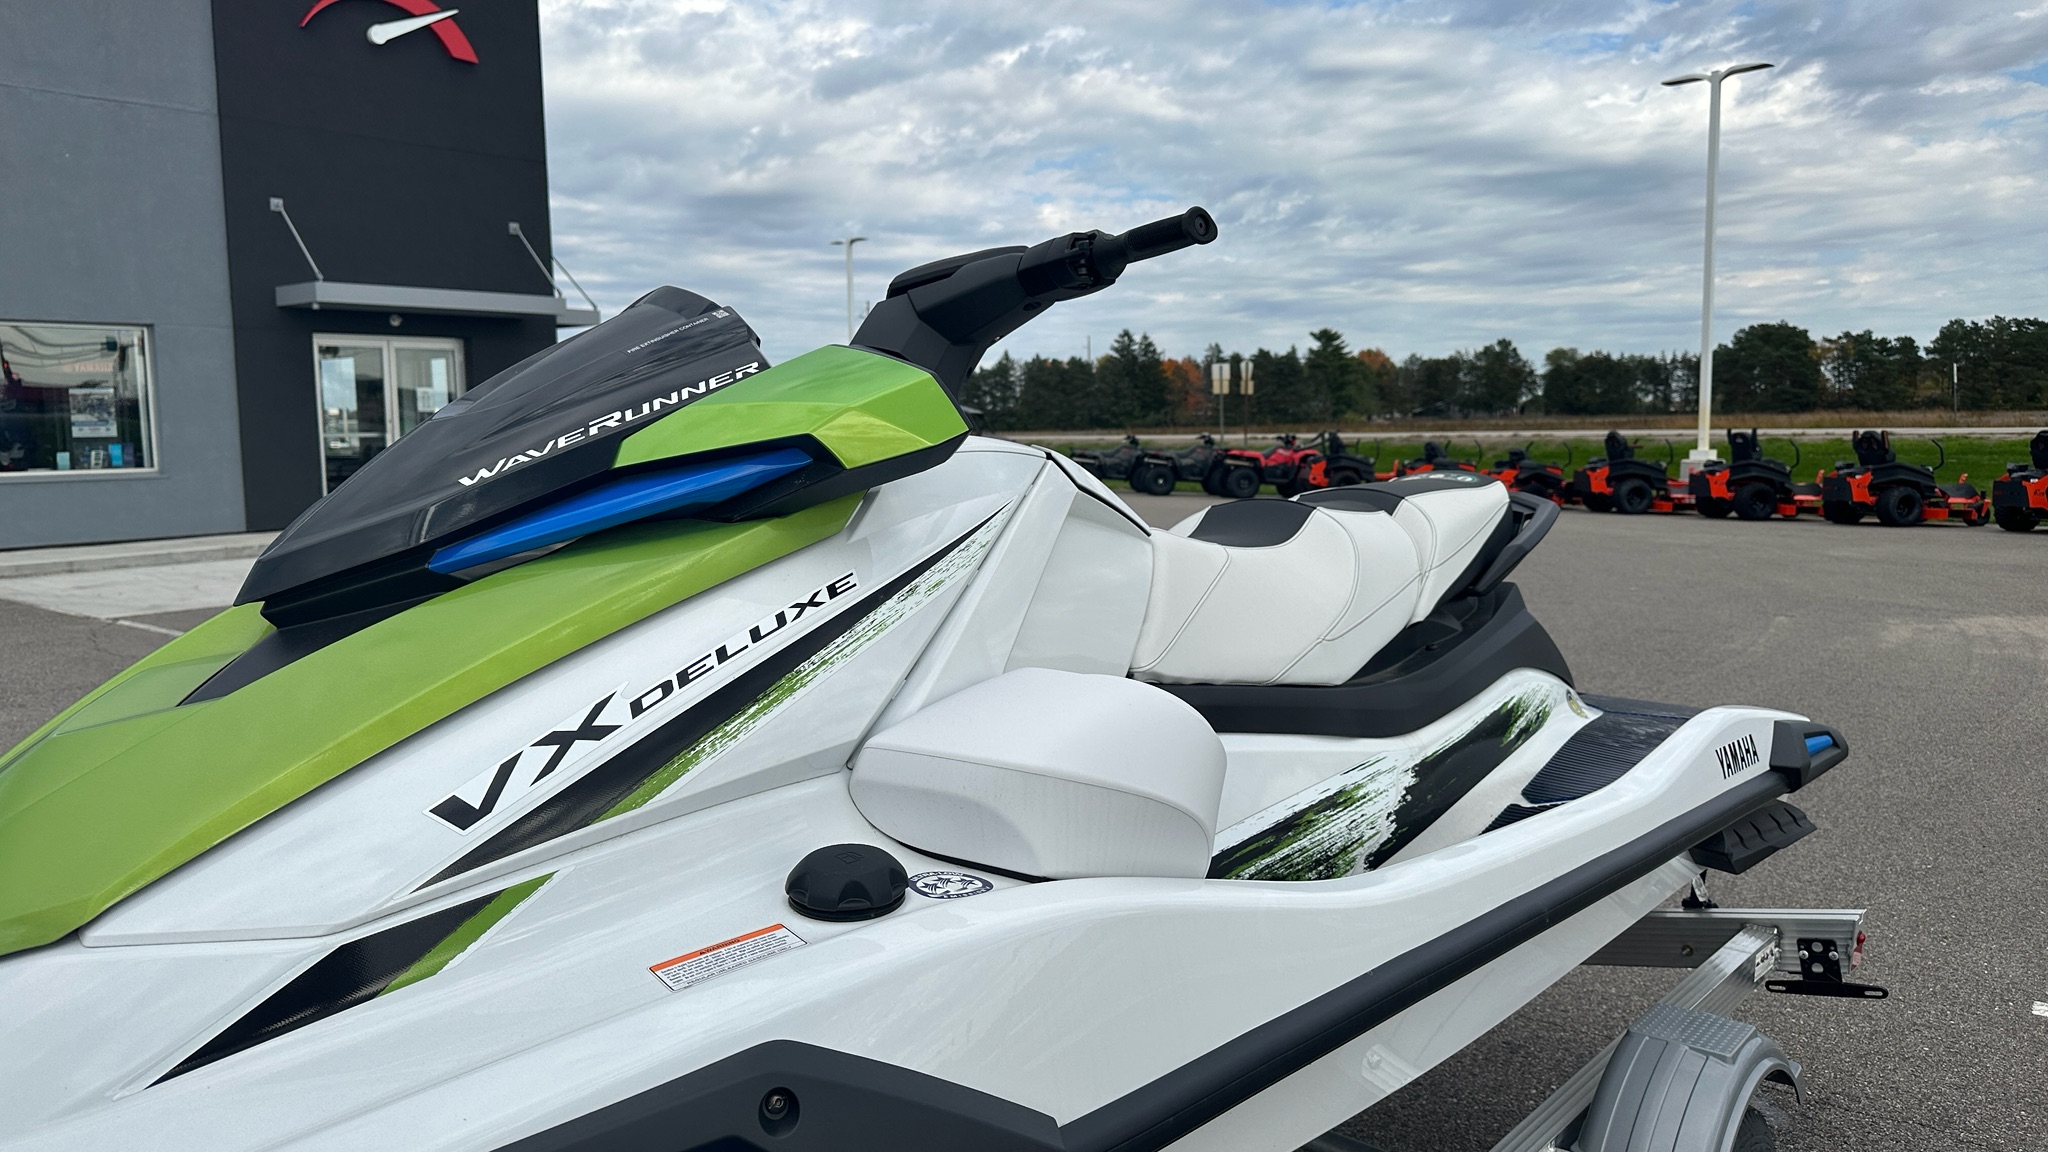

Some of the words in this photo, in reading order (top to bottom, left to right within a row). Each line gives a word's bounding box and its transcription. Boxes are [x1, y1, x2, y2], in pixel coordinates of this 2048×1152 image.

[458, 361, 760, 487] WAVERUNNER
[429, 690, 624, 832] VX
[629, 572, 857, 720] DELUXE
[1715, 734, 1760, 779] YAMAHA
